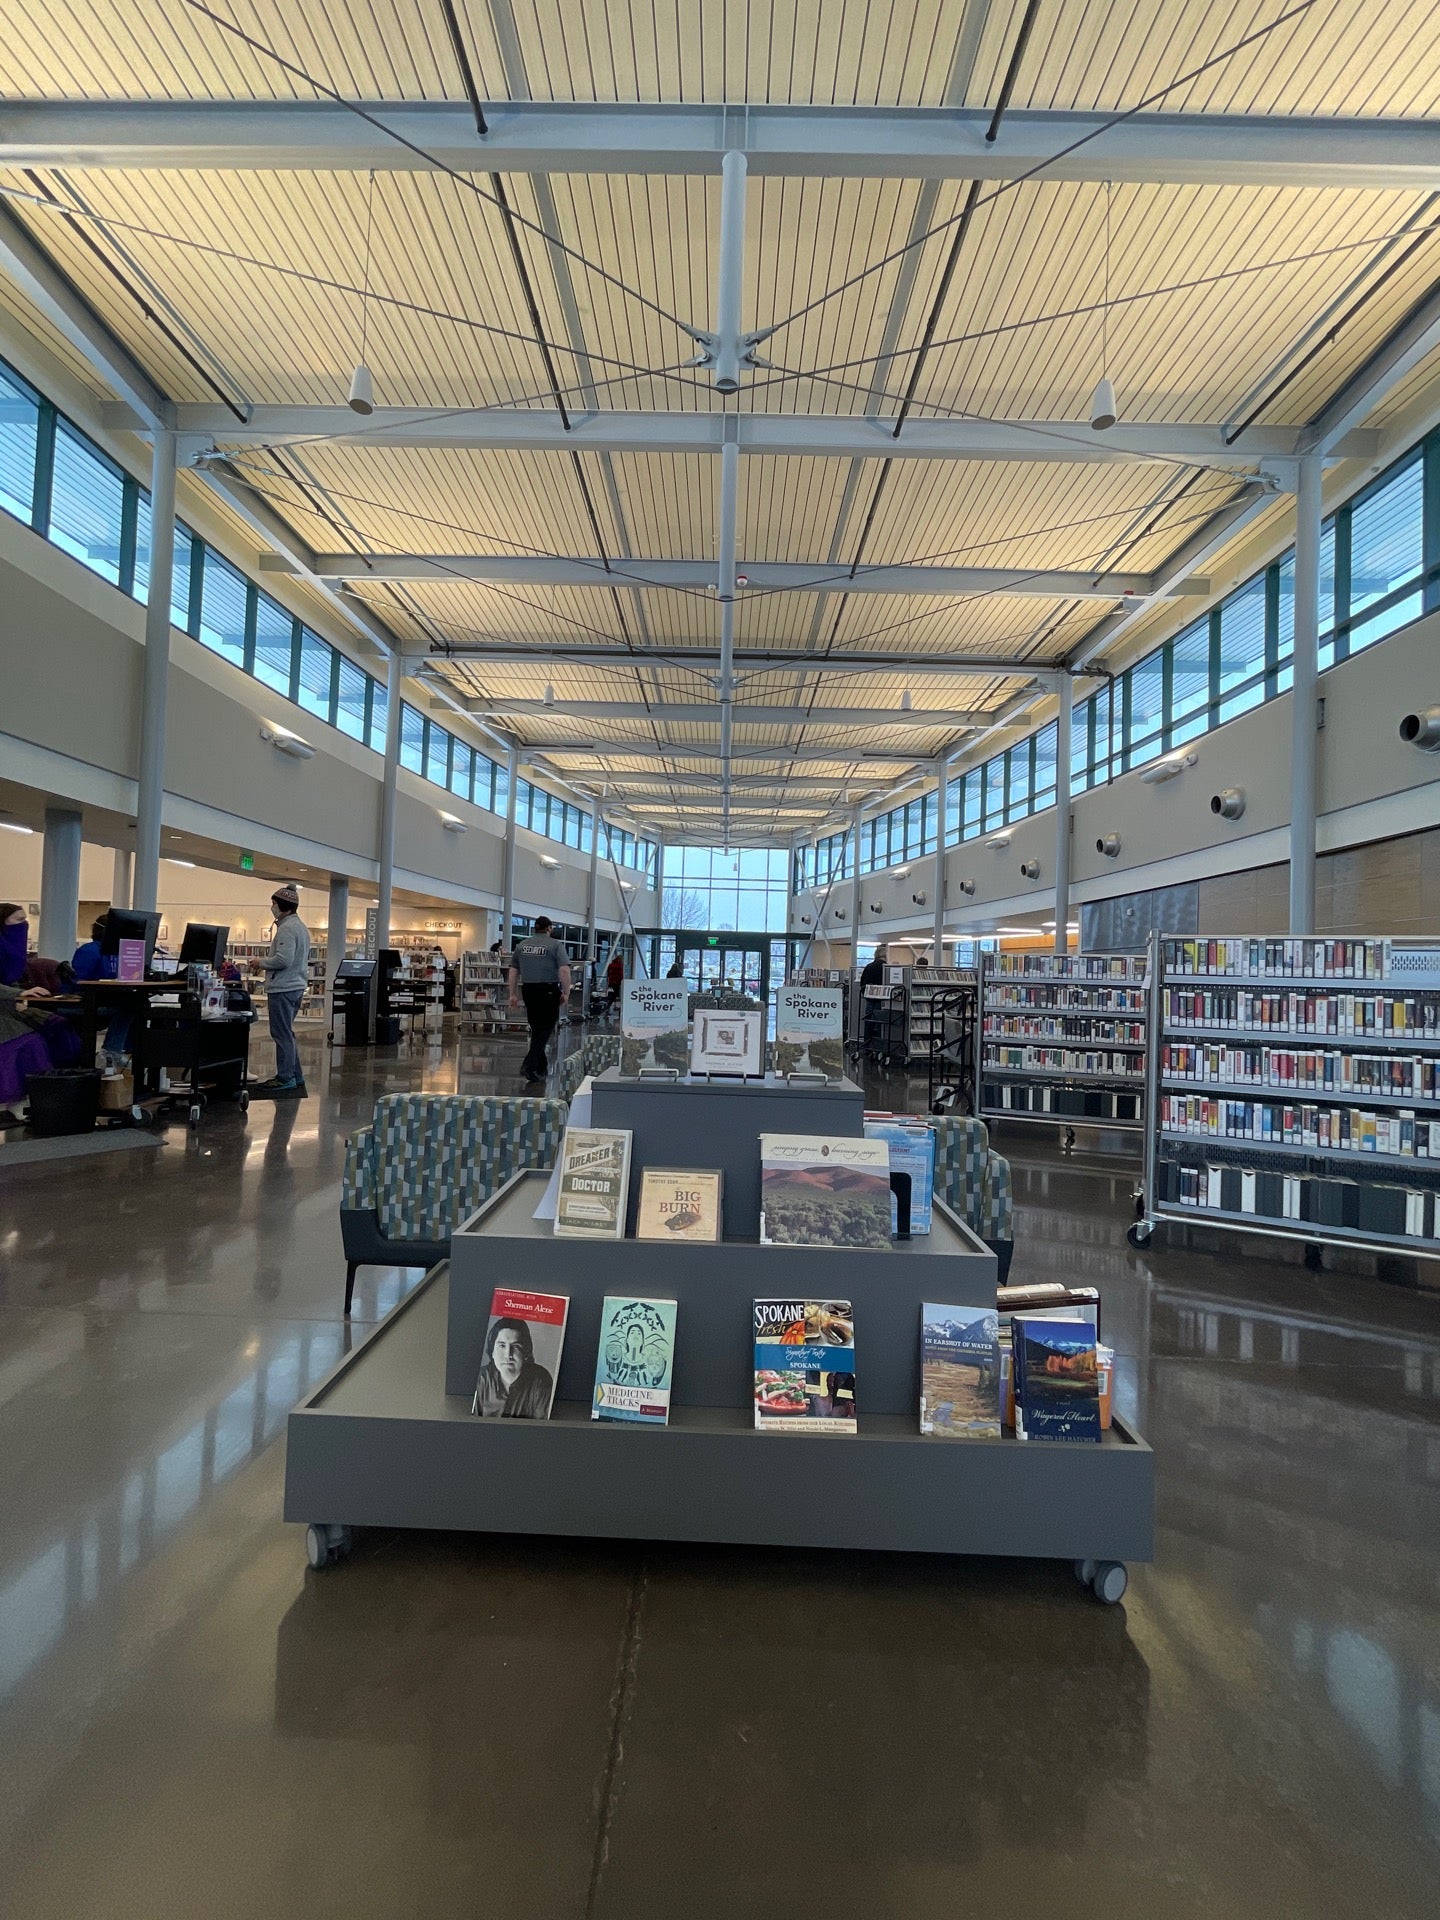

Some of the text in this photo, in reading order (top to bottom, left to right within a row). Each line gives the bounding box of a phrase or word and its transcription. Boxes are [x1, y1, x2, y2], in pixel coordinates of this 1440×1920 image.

[630, 990, 683, 1002] Spokane
[643, 1002, 675, 1012] River
[785, 998, 838, 1009] Spokane
[797, 1009, 829, 1019] River
[569, 1147, 610, 1169] DREAMER
[571, 1177, 611, 1193] DOCTOR
[674, 1191, 702, 1202] BIG
[658, 1202, 702, 1214] BURN
[504, 1299, 533, 1311] Sherman
[534, 1304, 555, 1314] Alexie
[755, 1305, 805, 1328] SPOKANE
[756, 1322, 787, 1336] fresh
[933, 1339, 961, 1347] EARSHOT
[971, 1342, 993, 1350] WATER
[607, 1386, 653, 1400] MEDICINE
[606, 1396, 640, 1408] TRACKS
[1031, 1408, 1095, 1425] Wagered Heart
